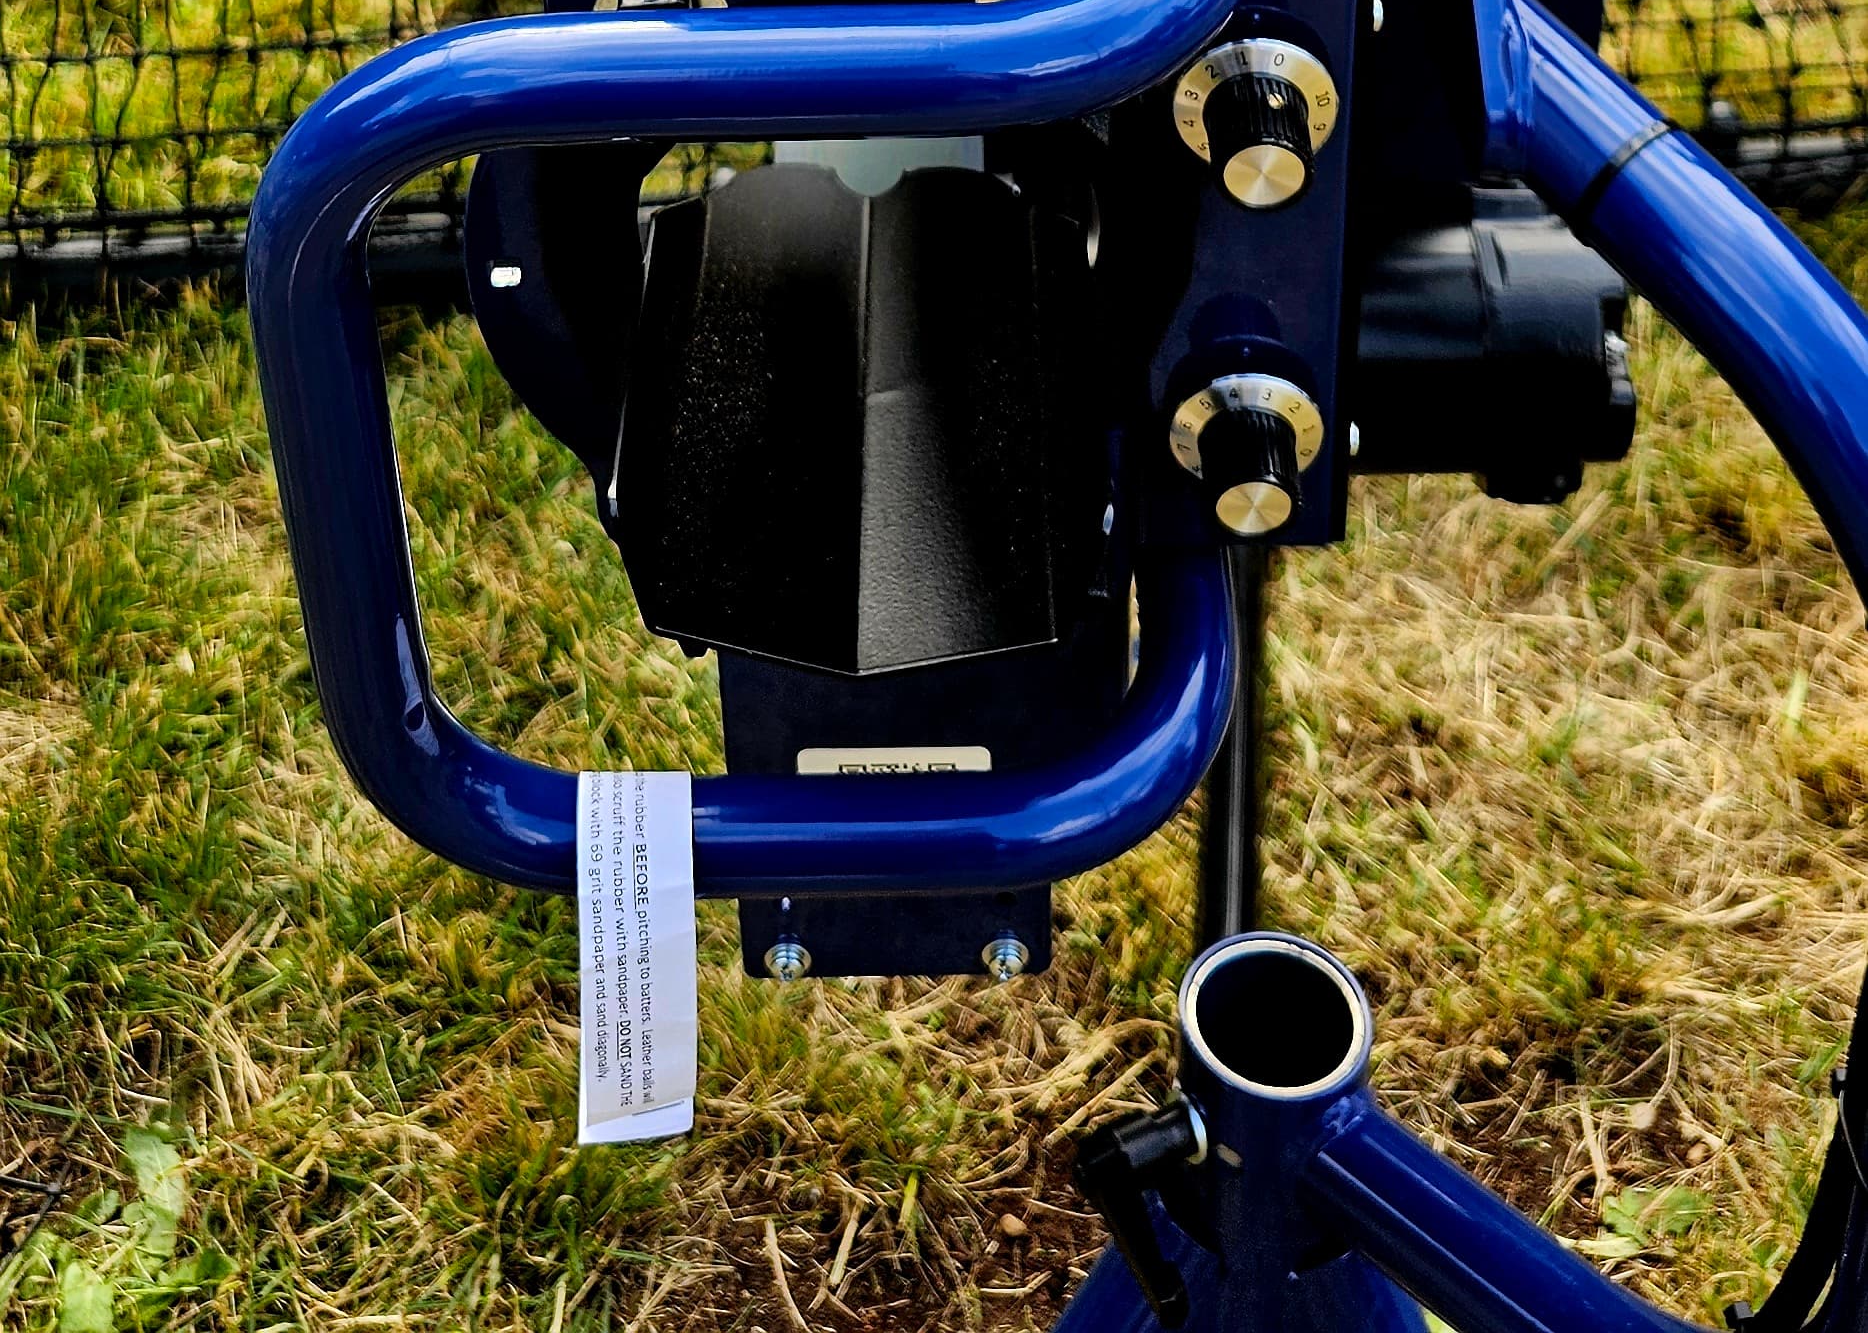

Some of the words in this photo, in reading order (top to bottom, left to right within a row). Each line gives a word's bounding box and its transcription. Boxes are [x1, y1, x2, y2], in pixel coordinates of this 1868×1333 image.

[1185, 90, 1198, 99] 3
[1205, 64, 1220, 79] 2
[1236, 52, 1249, 65] 1
[1274, 53, 1284, 66] 0
[1316, 90, 1330, 107] 10
[1200, 398, 1212, 410] 5
[1229, 388, 1238, 398] 4
[1262, 388, 1272, 400] 3
[1289, 402, 1302, 414] 2
[1180, 421, 1192, 429] 6
[1303, 425, 1315, 433] 1
[1177, 444, 1191, 452] 7
[613, 792, 626, 825] scruff
[635, 794, 647, 838] rubber
[590, 809, 603, 838] with
[591, 844, 603, 862] 69
[613, 831, 625, 855] the
[588, 868, 604, 894] grit
[613, 861, 628, 912] rubber
[635, 844, 649, 905] BEFORE
[592, 899, 607, 973] sandpaper
[616, 918, 629, 950] with
[635, 911, 652, 965] pitching
[640, 967, 650, 979] to
[596, 978, 608, 999] and
[616, 955, 630, 1018] sandpaper.
[597, 1003, 609, 1027] sand
[641, 982, 653, 1025] batters.
[620, 1021, 632, 1035] DO
[595, 1030, 610, 1082] diagonally.
[620, 1039, 632, 1058] NOT
[642, 1029, 653, 1066] Leather
[620, 1063, 632, 1089] SAND
[620, 1092, 632, 1107] THE
